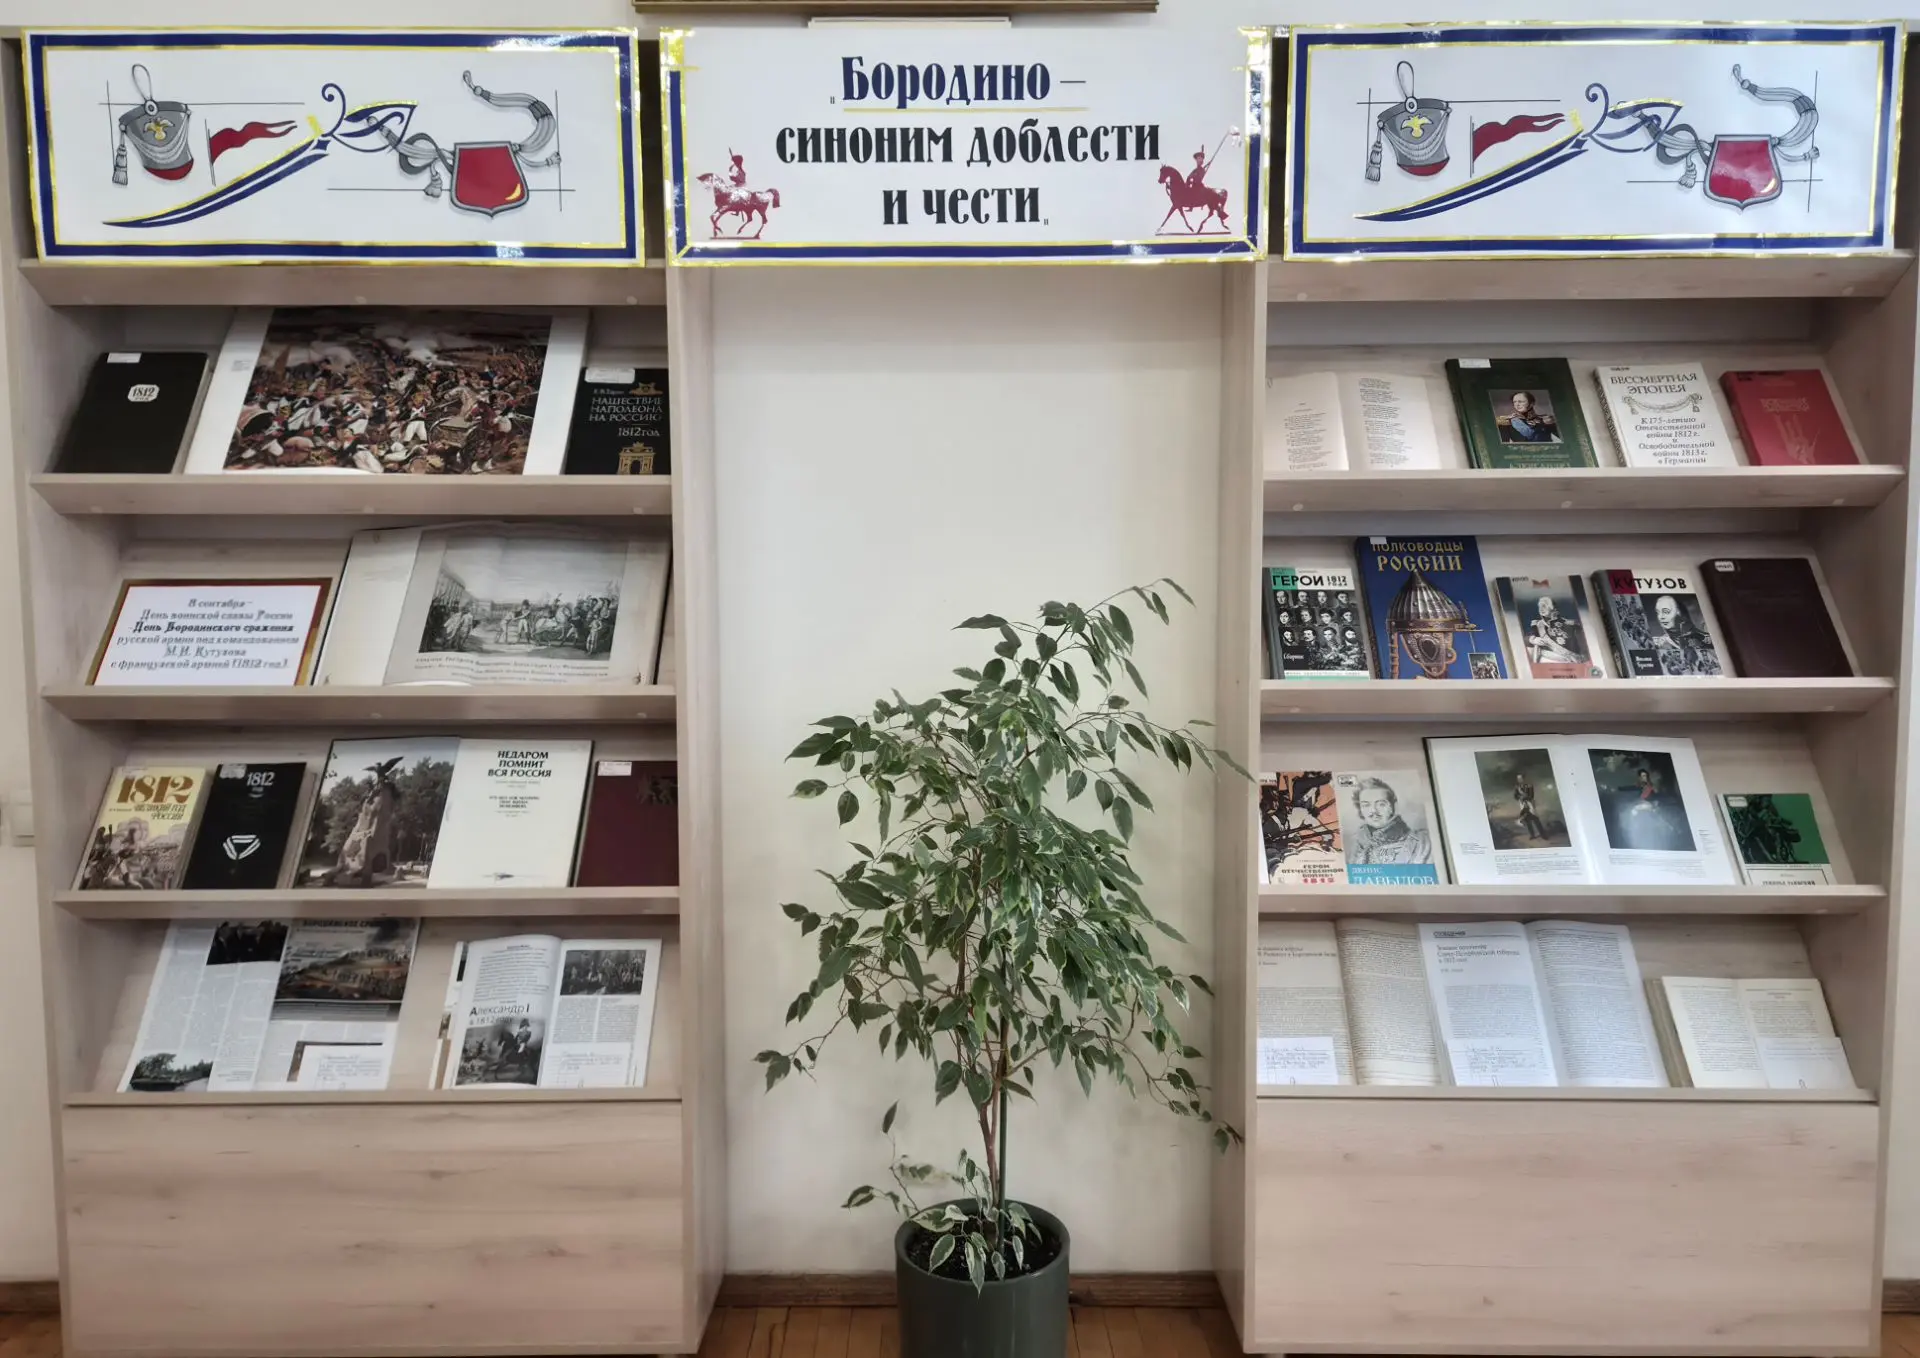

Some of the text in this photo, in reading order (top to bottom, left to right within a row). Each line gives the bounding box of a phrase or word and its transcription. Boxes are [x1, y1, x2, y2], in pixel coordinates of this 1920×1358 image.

[776, 118, 1160, 167] синоним доблести
[883, 189, 908, 225] и
[1610, 372, 1698, 384] БЕССМЕРТНАЯ
[132, 386, 156, 397] 1812
[1627, 384, 1686, 394] ЭПОПЕЯ
[592, 397, 662, 405] НАШЕСТВИЕ
[591, 405, 663, 413] НАПОЛЕОНА
[609, 413, 662, 421] РОССИЮ
[1372, 542, 1464, 553] ПОЛКОВОДЦЫ
[1377, 555, 1463, 572] РОССИИ
[1272, 575, 1324, 586] ГЕРОИ
[1613, 577, 1687, 589] КУТУЗОВ
[141, 609, 169, 621] День
[171, 611, 219, 620] воинской
[255, 609, 293, 621] России
[133, 621, 295, 633] День Бородинского сражения
[117, 635, 160, 645] русской
[497, 750, 549, 759] НЕДАРОМ
[499, 760, 545, 768] ПОМНИТ
[488, 768, 552, 777] ВСЯ РОССИЯ
[247, 772, 275, 786] 1812
[117, 775, 194, 803] 1812
